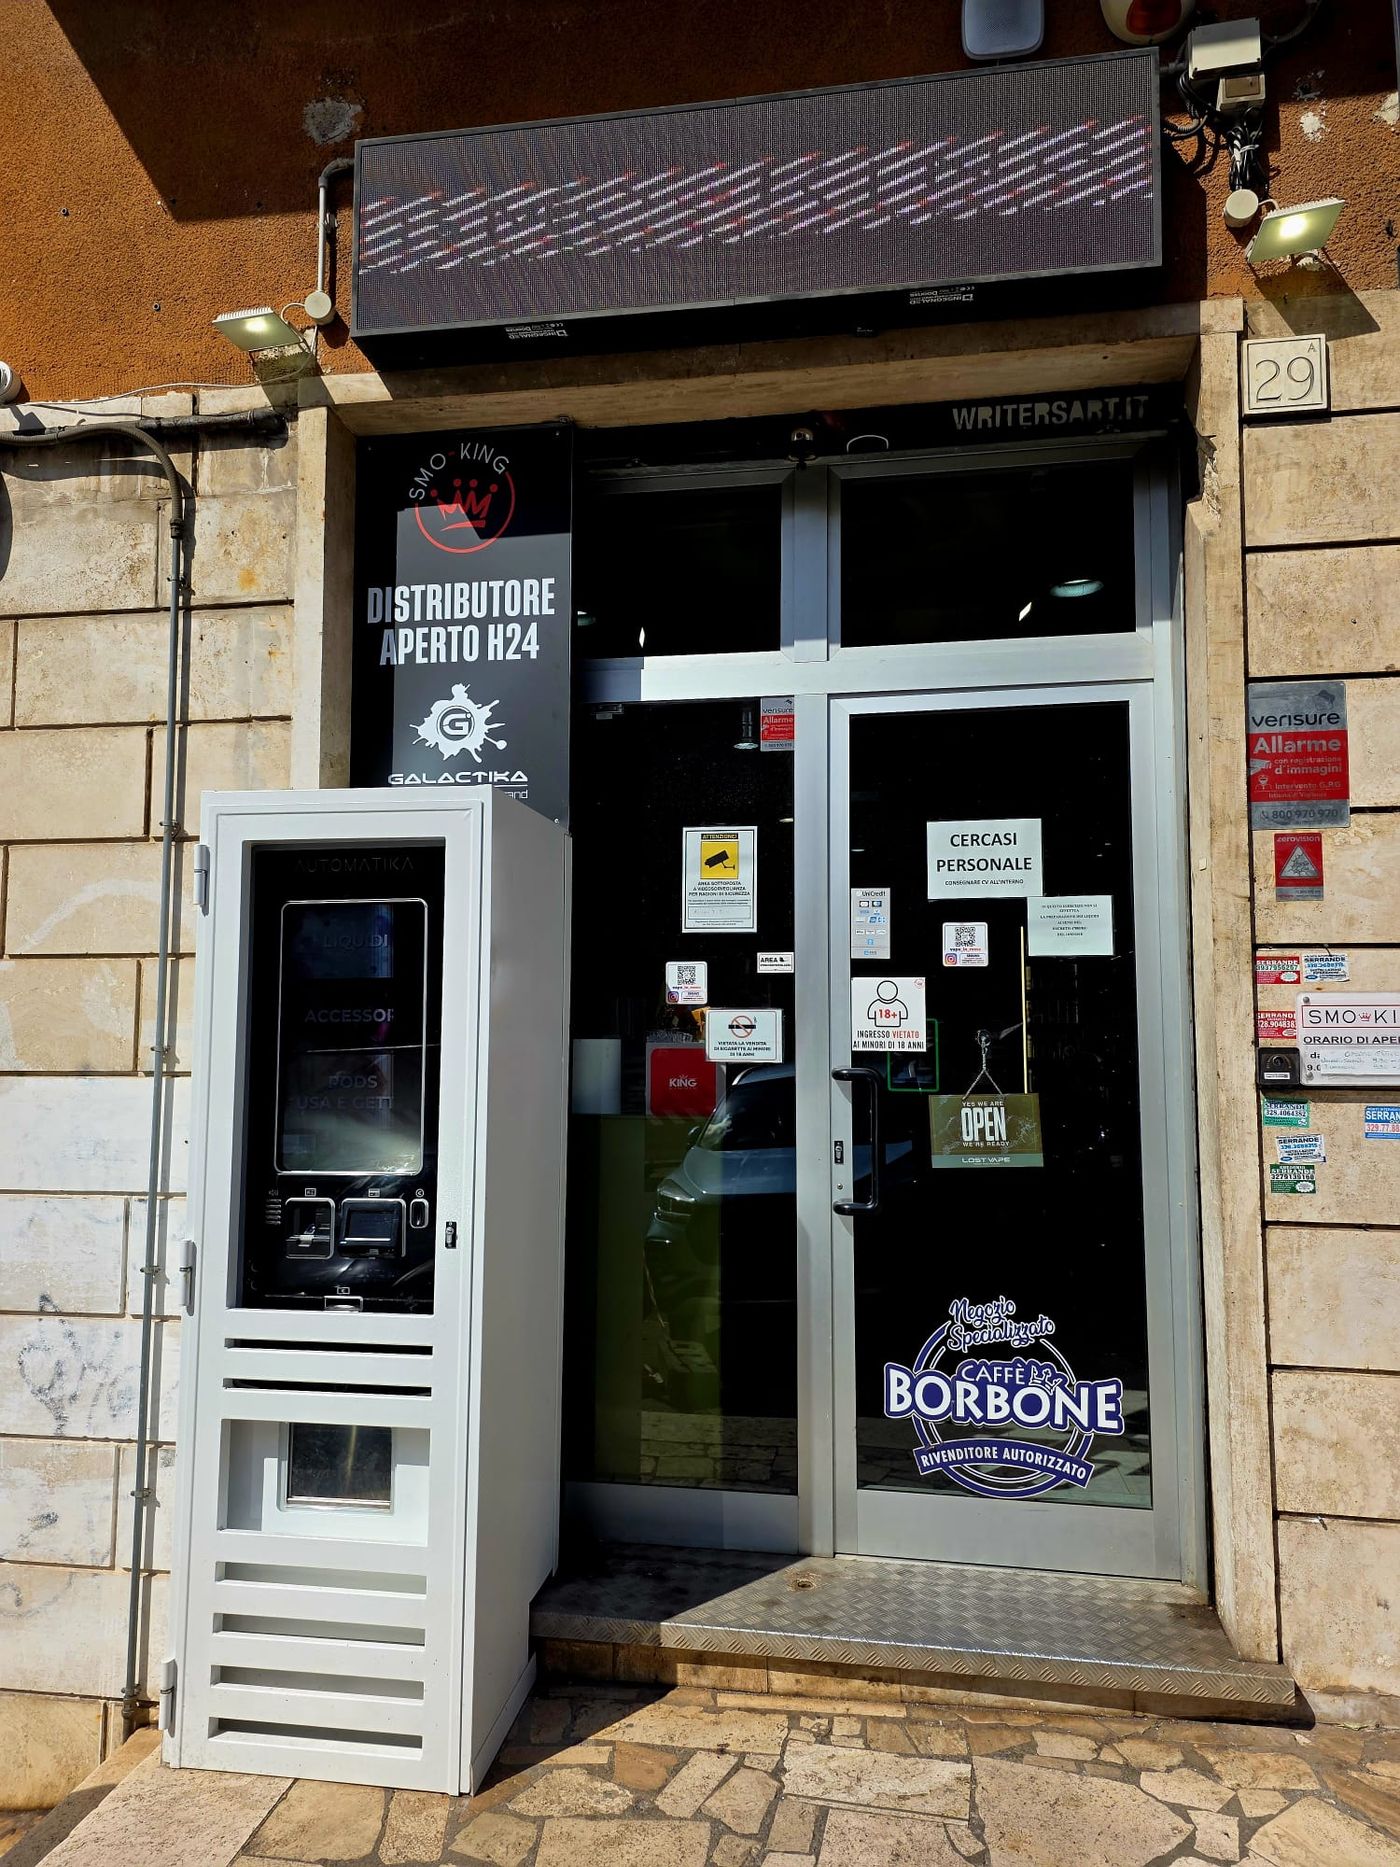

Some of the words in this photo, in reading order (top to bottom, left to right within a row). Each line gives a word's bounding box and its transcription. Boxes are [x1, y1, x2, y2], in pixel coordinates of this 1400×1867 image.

[1307, 342, 1316, 352] A
[1255, 356, 1315, 403] 29
[952, 395, 1149, 430] WRITERSART.IT
[367, 577, 555, 625] DISTRIBUTORE
[379, 623, 479, 666] APERTO
[487, 621, 540, 662] H24
[763, 716, 793, 724] Allarme
[1251, 712, 1340, 728] verisure
[1253, 735, 1342, 754] Allarme
[1290, 756, 1342, 766] registrazione
[387, 770, 528, 785] GALACTIKA
[1272, 810, 1293, 819] 800
[1294, 809, 1316, 818] 970
[1317, 808, 1339, 818] 970
[950, 832, 1017, 847] CERCASI
[936, 857, 1032, 872] PERSONALE
[879, 1009, 897, 1019] 18+
[1308, 1010, 1356, 1024] SMO
[857, 1030, 890, 1039] INGRESSO
[892, 1030, 920, 1038] VIETATO
[1303, 1036, 1353, 1044] ORARIO
[1356, 1036, 1368, 1044] DI
[853, 1041, 860, 1049] AI
[861, 1041, 886, 1049] MINORI
[888, 1041, 894, 1049] DI
[898, 1041, 905, 1049] 18
[907, 1041, 924, 1049] ANNI
[669, 1078, 697, 1087] KING
[961, 1106, 1007, 1141] OPEN
[949, 1296, 1016, 1326] Negozio
[948, 1314, 1055, 1352] Specializzato
[961, 1363, 1025, 1385] CAFFÈ
[887, 1365, 1120, 1430] BORBONE
[920, 1446, 998, 1467] RIVENDITORE
[1002, 1447, 1087, 1480] AUTORIZZATO
